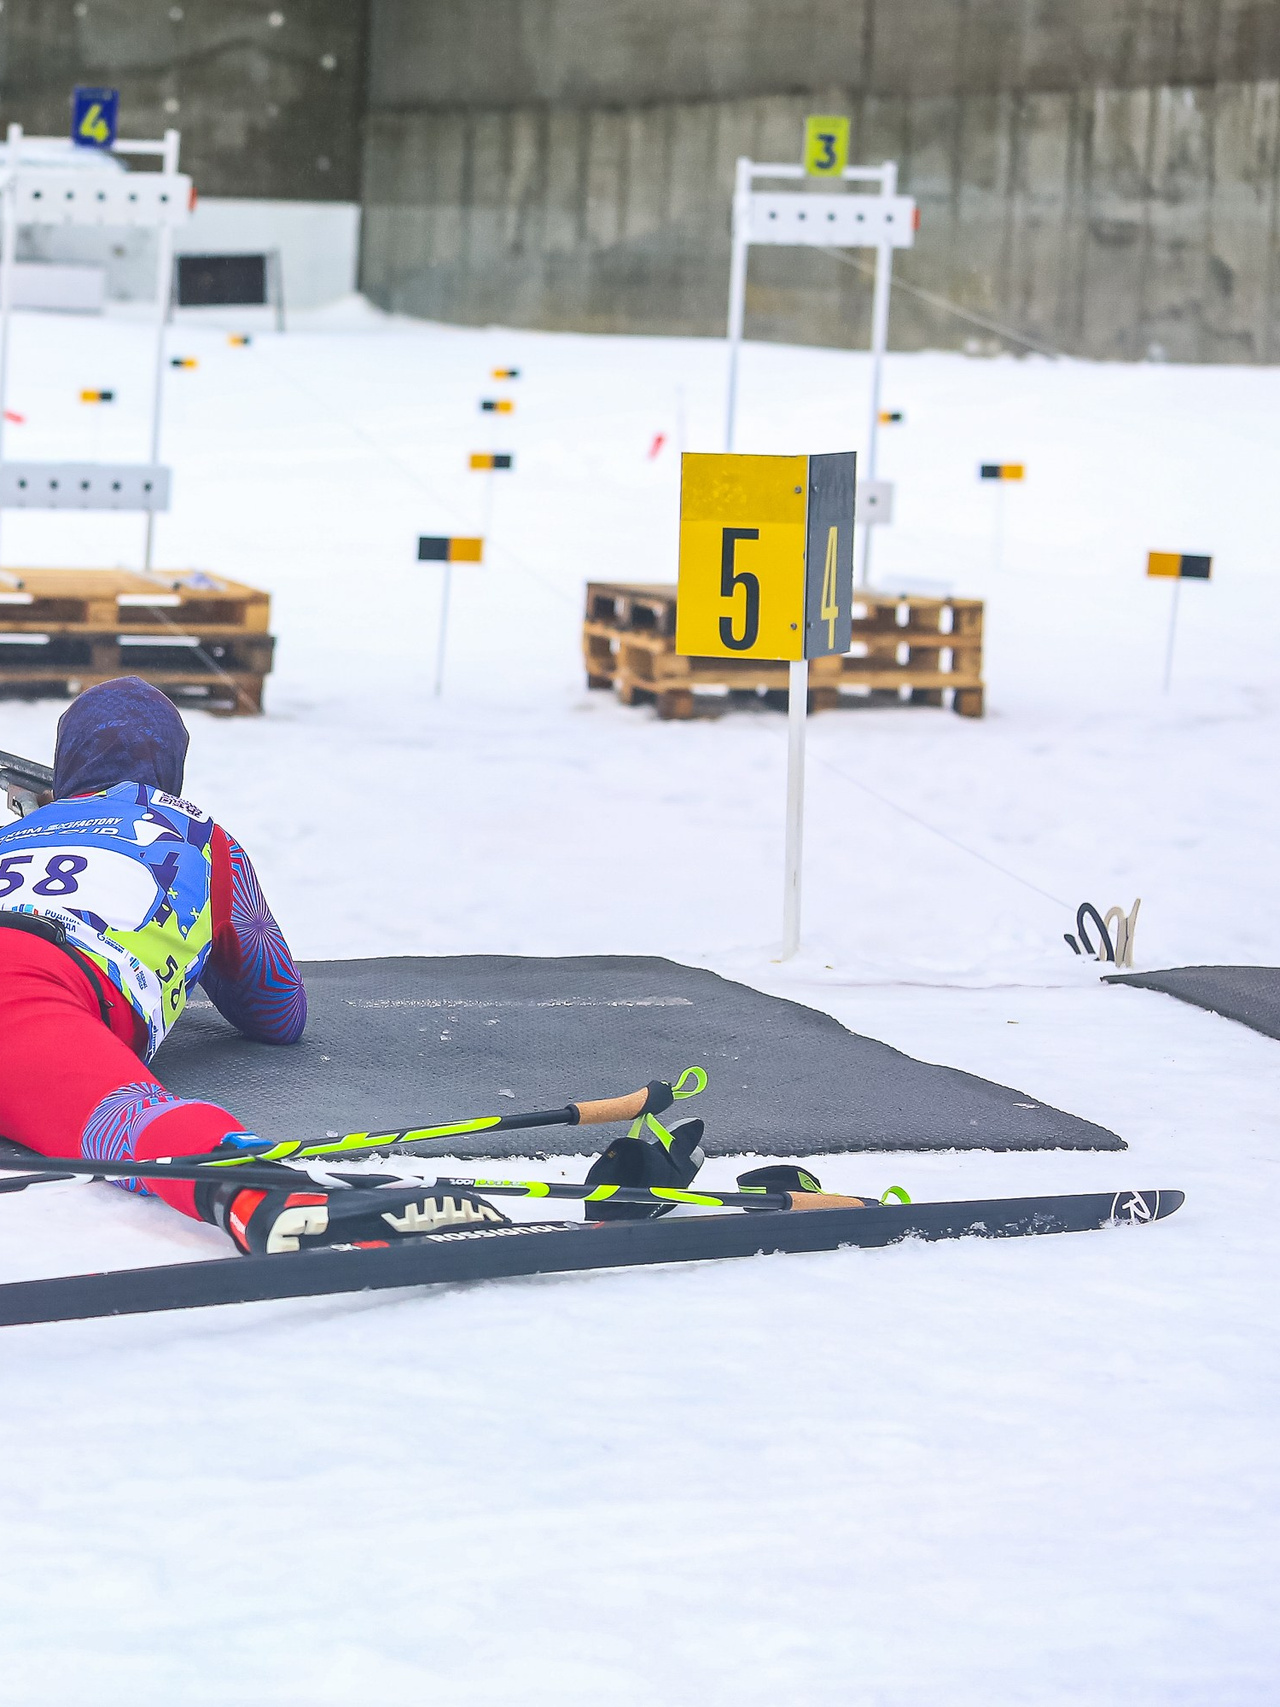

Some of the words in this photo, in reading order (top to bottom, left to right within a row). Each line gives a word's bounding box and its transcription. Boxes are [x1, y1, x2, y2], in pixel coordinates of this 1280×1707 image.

[79, 103, 110, 143] 4
[814, 133, 837, 170] 3
[718, 527, 760, 651] 5
[821, 526, 839, 650] 4
[426, 1224, 571, 1243] ROSSIGNOL
